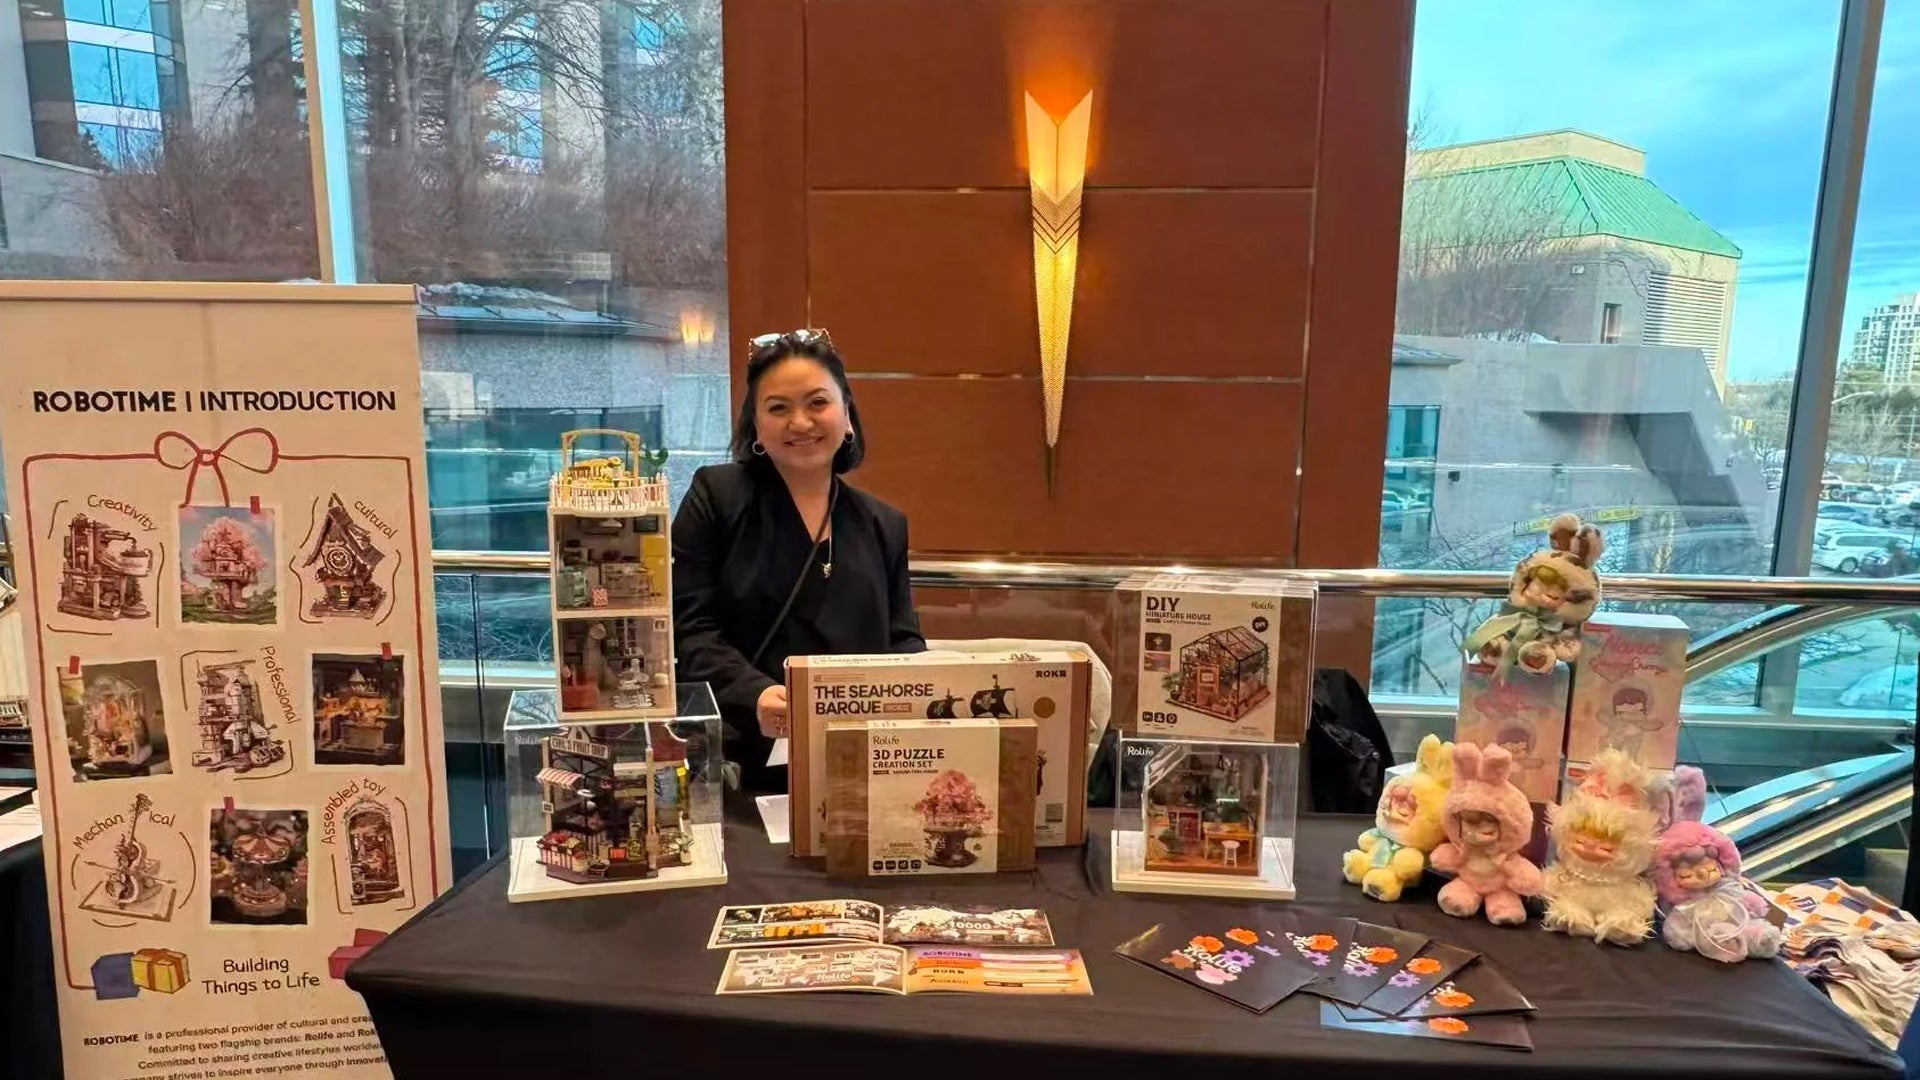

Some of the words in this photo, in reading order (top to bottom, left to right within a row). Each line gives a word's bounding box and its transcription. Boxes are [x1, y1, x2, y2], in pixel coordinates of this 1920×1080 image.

[33, 391, 177, 412] ROBOTIME
[200, 391, 396, 411] INTRODUCTION
[87, 494, 159, 532] Creativity
[1146, 596, 1180, 611] DIY
[260, 646, 302, 724] Professional
[814, 685, 846, 699] THE
[849, 683, 934, 698] SEAHORSE
[815, 701, 881, 715] BARQUE
[872, 735, 900, 745] Rolife
[873, 749, 890, 760] 3D
[894, 748, 944, 760] PUZZLE
[1127, 746, 1154, 756] Rolife
[917, 760, 932, 768] SET
[321, 780, 360, 845] Assembled
[362, 778, 386, 796] toy
[223, 957, 289, 973] Building
[201, 979, 258, 995] Things
[262, 979, 281, 990] to
[286, 972, 320, 988] Life
[84, 1033, 140, 1046] ROBOTIME
[144, 1031, 154, 1040] is
[165, 1025, 229, 1039] professional
[231, 1023, 274, 1034] provider
[276, 1021, 287, 1030] of
[290, 1018, 328, 1028] cultural
[331, 1016, 349, 1025] and
[148, 1043, 196, 1054] featuring
[198, 1042, 218, 1050] two
[220, 1037, 261, 1049] flagship
[304, 1031, 334, 1042] Rolife
[336, 1029, 355, 1039] and
[138, 1056, 196, 1070] Committed
[198, 1056, 209, 1064] to
[212, 1051, 250, 1063] sharing
[252, 1050, 293, 1061] creative
[218, 1065, 252, 1078] inspire
[255, 1063, 302, 1076] everyone
[305, 1058, 344, 1070] through
